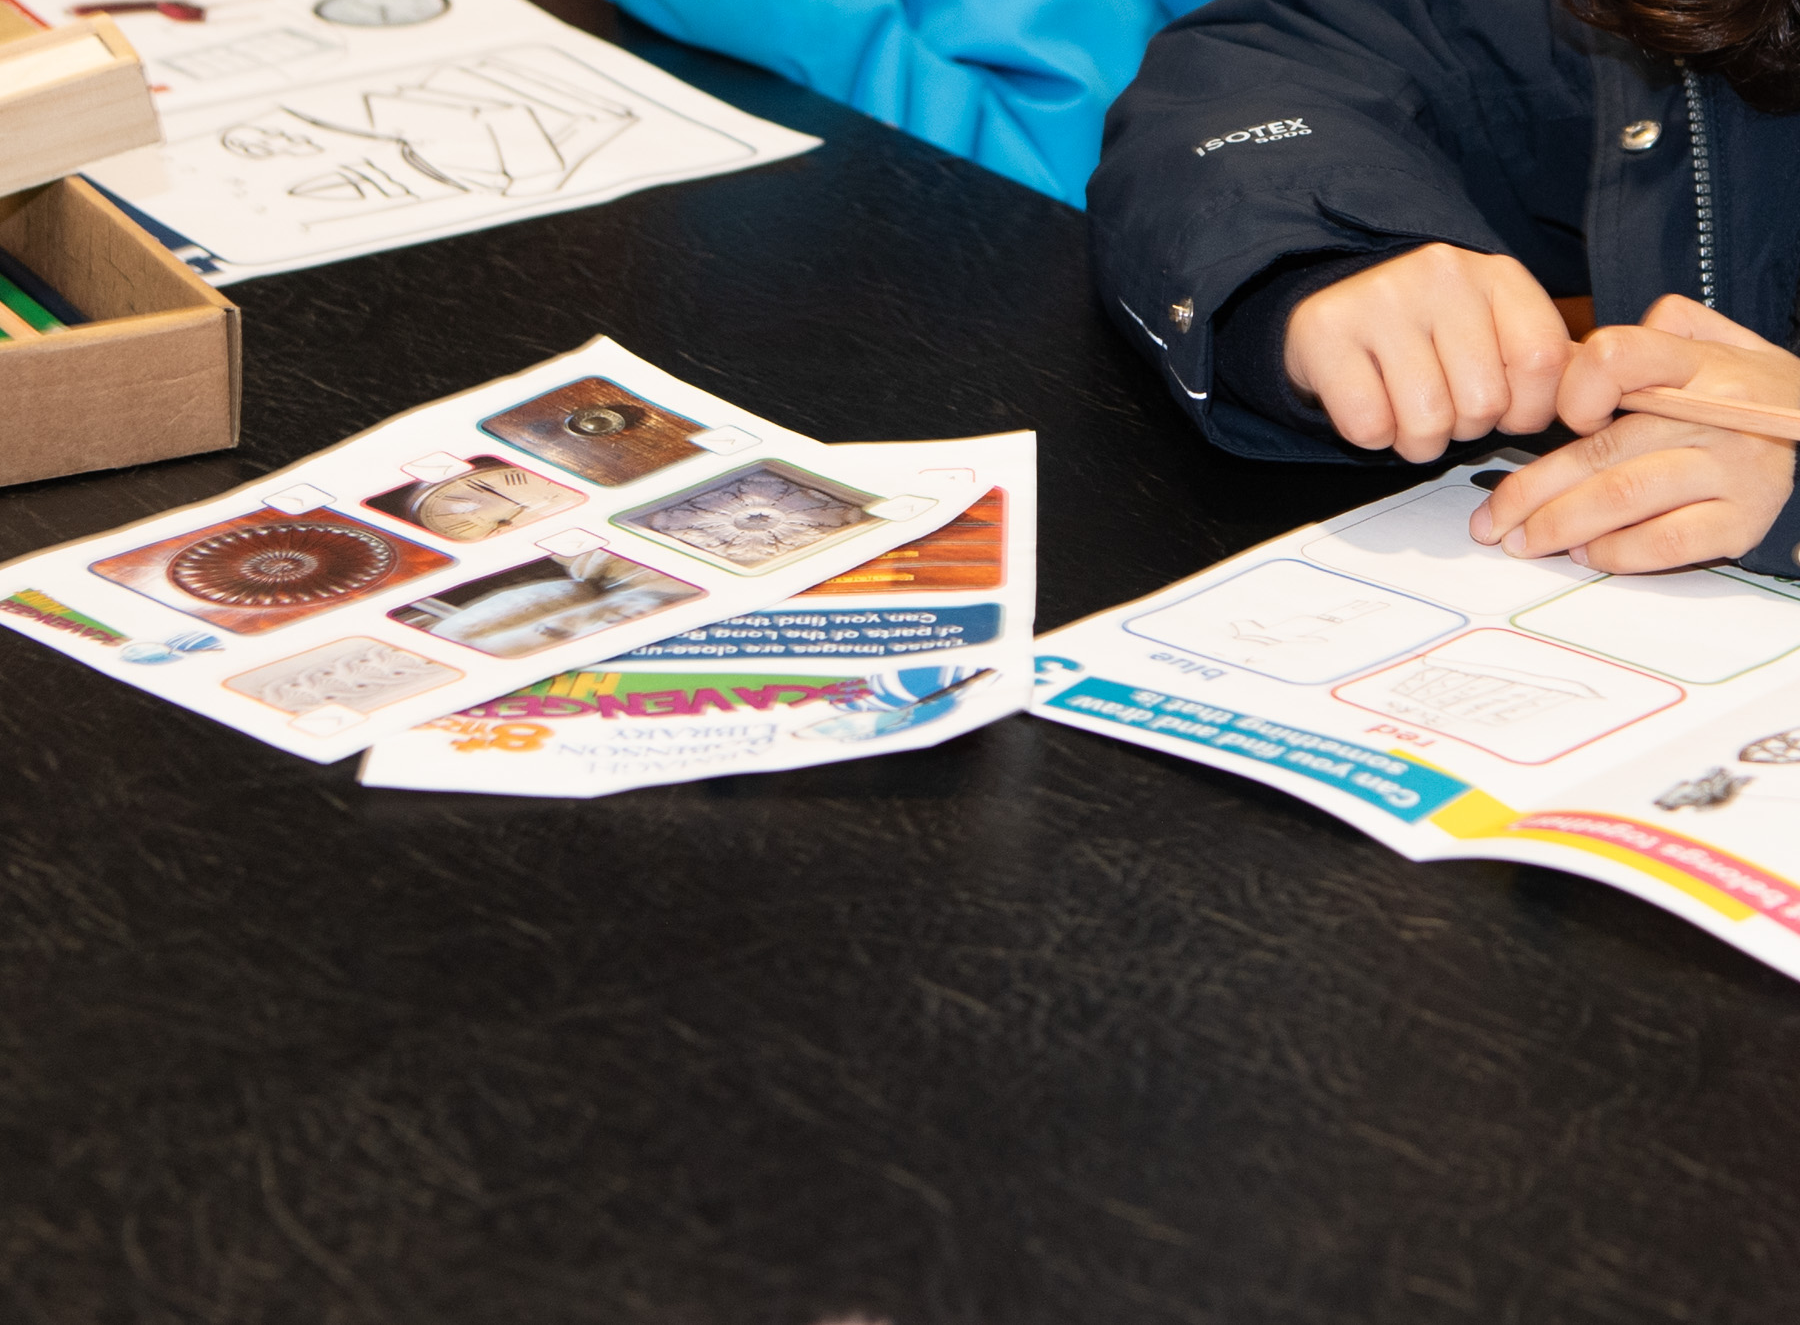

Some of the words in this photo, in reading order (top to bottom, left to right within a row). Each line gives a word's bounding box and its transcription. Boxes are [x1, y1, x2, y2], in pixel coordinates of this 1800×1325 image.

[1195, 118, 1309, 157] ISOTEX
[1255, 128, 1313, 144] 5000
[778, 616, 828, 626] find
[834, 613, 881, 623] you
[887, 613, 937, 624] Can
[714, 628, 778, 641] Long
[784, 630, 828, 641] the
[832, 630, 860, 641] of
[866, 626, 932, 638] parts
[938, 626, 964, 637] of
[744, 645, 786, 654] are
[793, 643, 885, 655] images
[891, 637, 968, 653] These
[1148, 651, 1228, 682] blue
[1129, 689, 1166, 708] is
[1063, 694, 1154, 723] draw
[1161, 699, 1235, 725] that
[1148, 714, 1220, 739] and
[1363, 723, 1436, 748] red
[1211, 731, 1287, 760] find
[1233, 716, 1410, 776] something
[1284, 750, 1355, 779] you
[1351, 772, 1421, 809] Can
